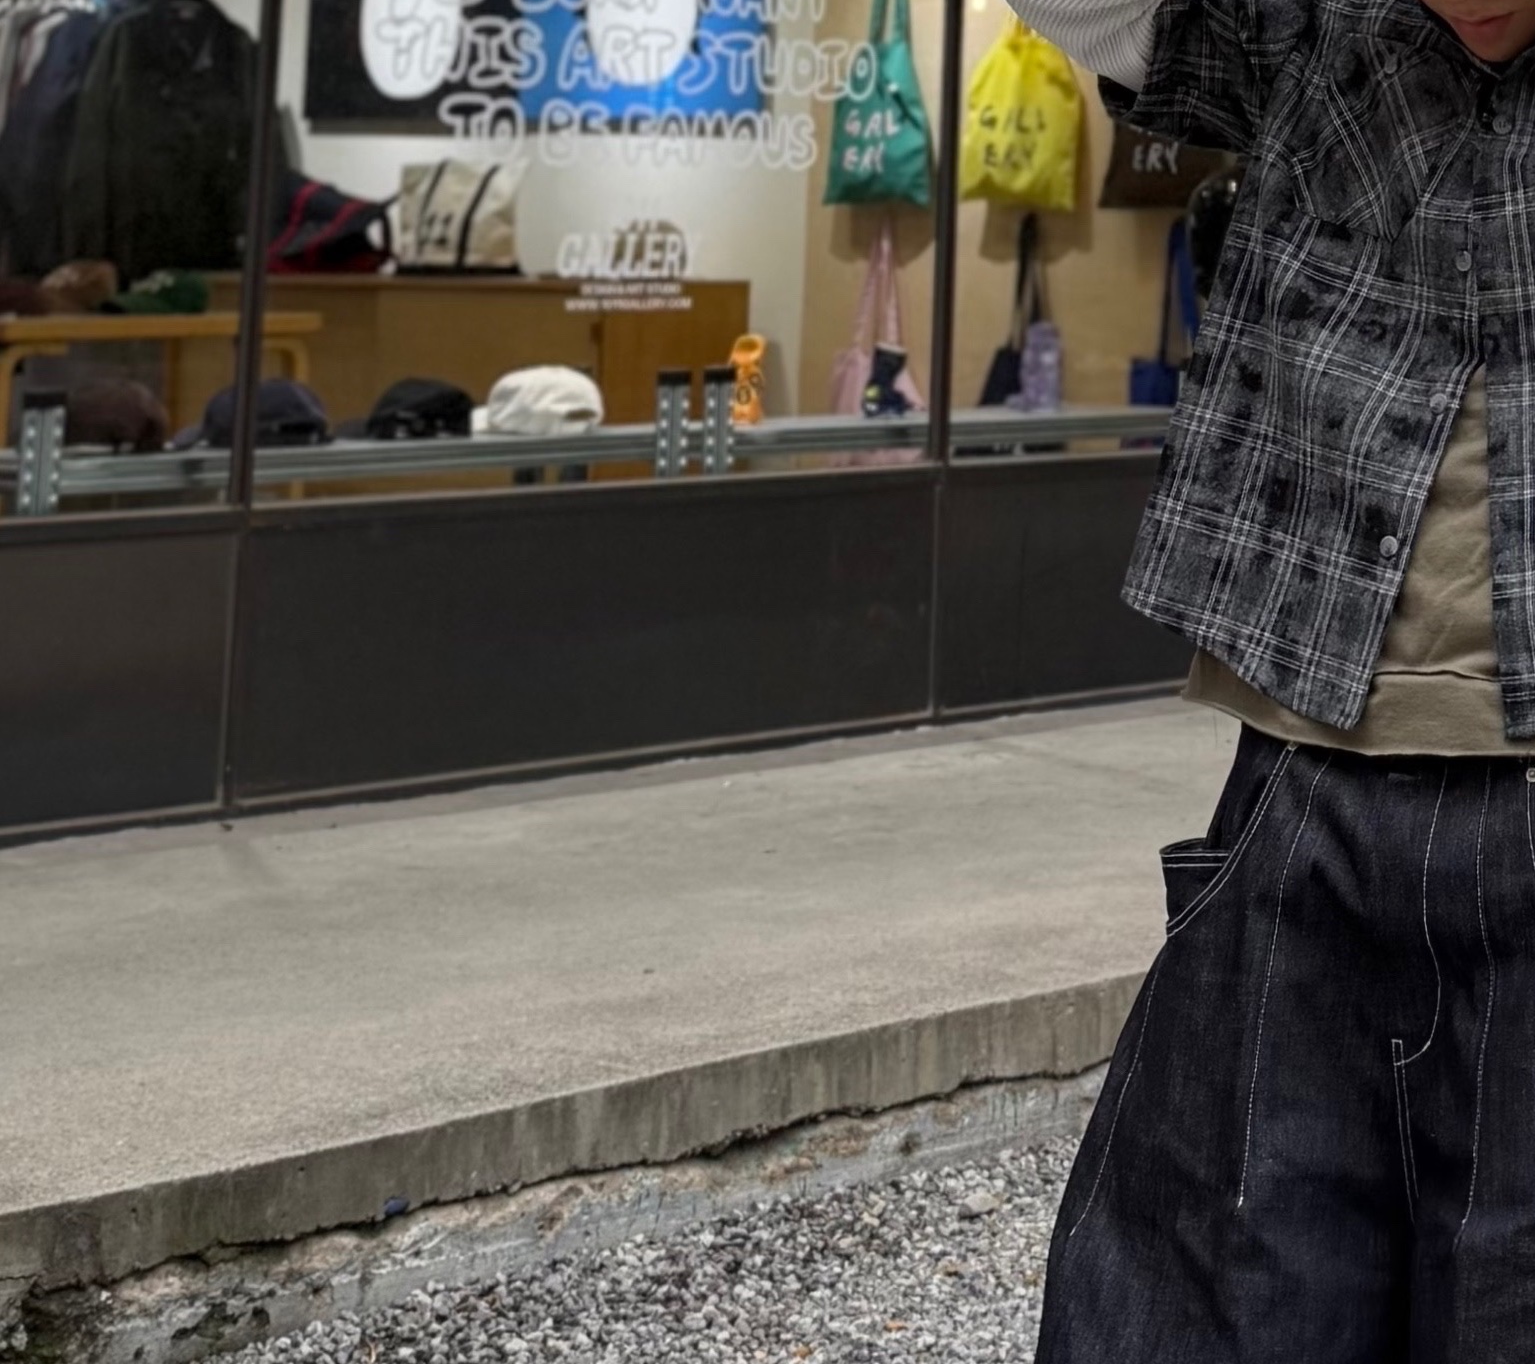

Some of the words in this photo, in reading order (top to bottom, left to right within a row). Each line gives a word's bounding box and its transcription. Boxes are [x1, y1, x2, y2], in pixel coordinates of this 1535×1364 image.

[375, 13, 548, 90] THIS
[556, 21, 677, 92] ART
[676, 27, 877, 102] STUDIO
[619, 104, 819, 172] FAMOUS
[1132, 141, 1179, 175] ERY
[556, 232, 701, 280] GALLERY
